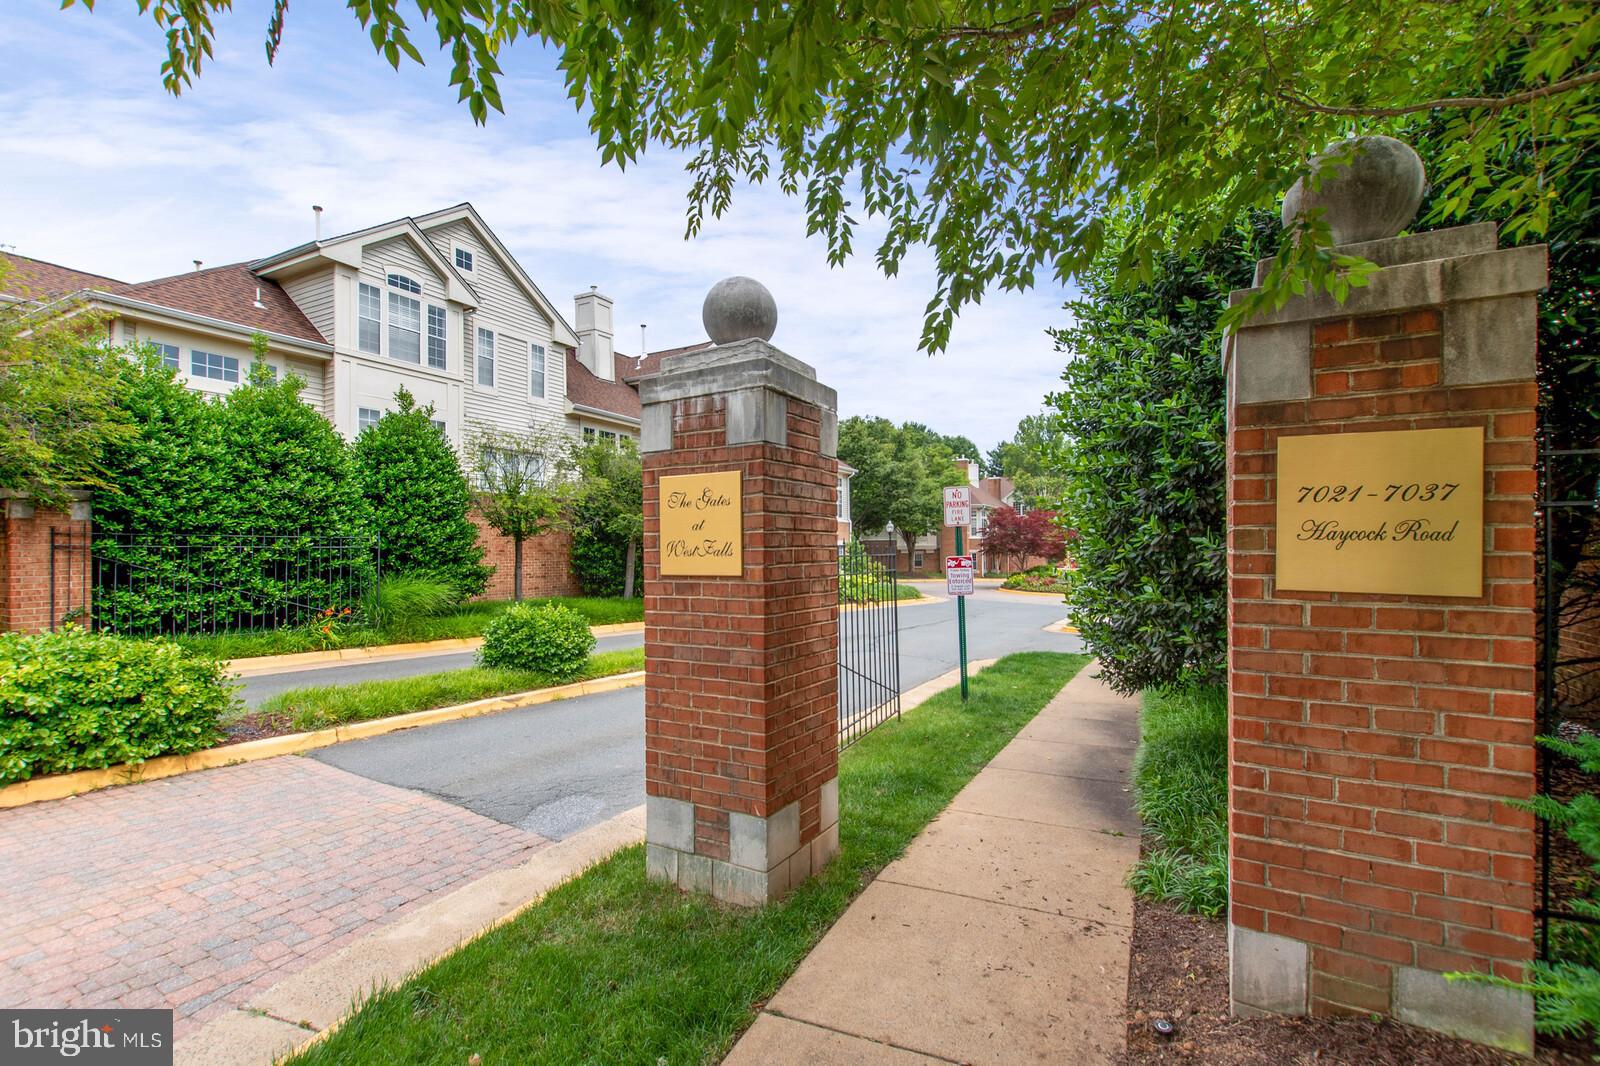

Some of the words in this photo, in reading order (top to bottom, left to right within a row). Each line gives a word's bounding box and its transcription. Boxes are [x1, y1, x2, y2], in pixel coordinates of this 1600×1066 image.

[667, 491, 692, 509] The
[696, 487, 731, 510] Gates
[952, 491, 962, 499] NO
[946, 500, 969, 508] PARKING
[692, 519, 705, 531] at
[1297, 519, 1388, 551] Haycock
[1392, 518, 1460, 542] Road
